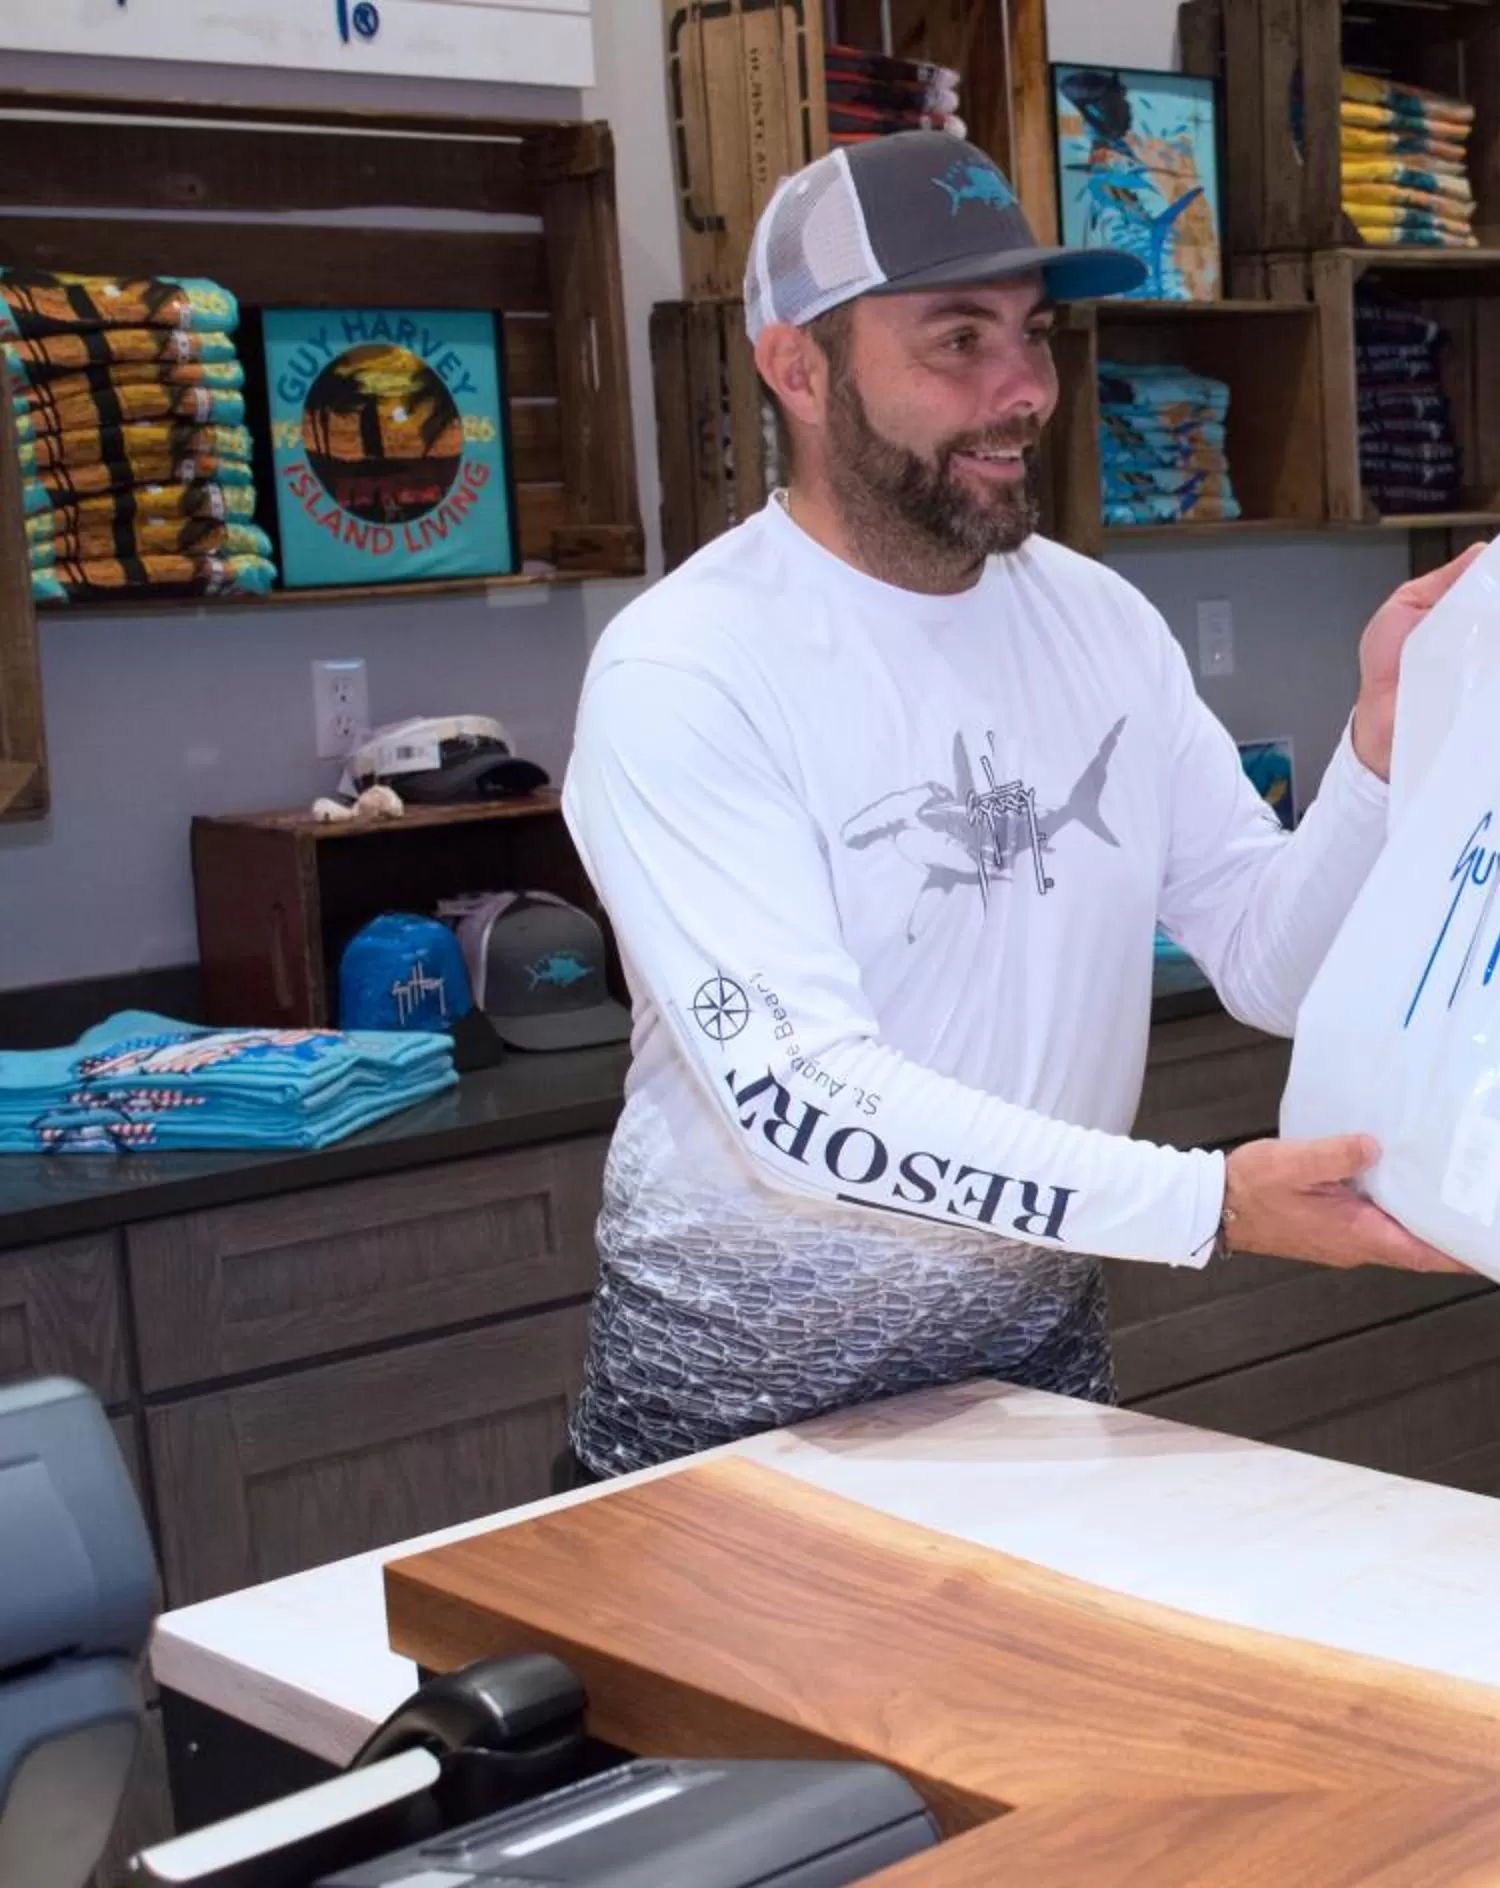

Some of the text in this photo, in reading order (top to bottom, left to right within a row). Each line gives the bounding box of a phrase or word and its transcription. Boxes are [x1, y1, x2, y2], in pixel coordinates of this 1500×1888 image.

[277, 312, 478, 404] GUY HARVEY
[283, 460, 491, 555] ISLAND LIVING
[723, 1064, 1080, 1243] RESORT
